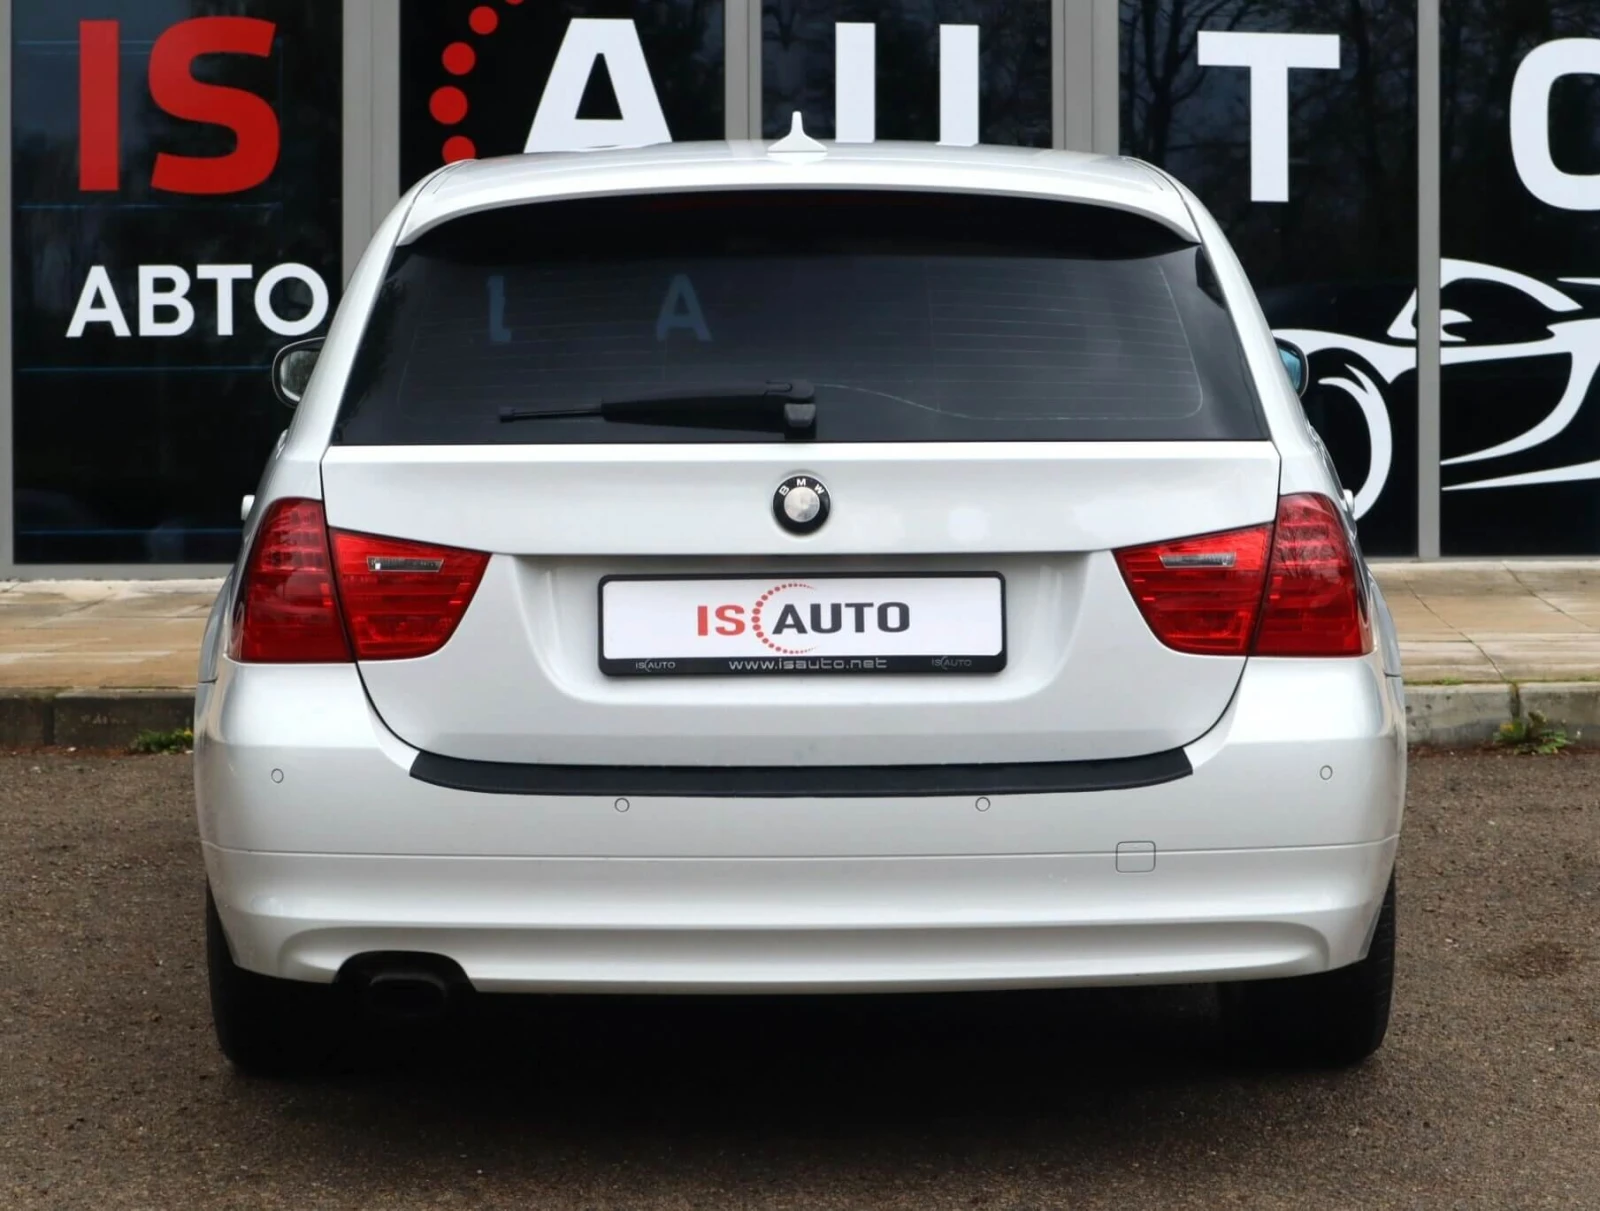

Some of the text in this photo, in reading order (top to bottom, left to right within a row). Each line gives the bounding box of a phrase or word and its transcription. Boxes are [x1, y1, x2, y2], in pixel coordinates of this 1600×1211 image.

[79, 16, 280, 194] IS
[66, 262, 329, 338] АВТО
[778, 477, 825, 496] BMW
[697, 601, 910, 636] IS AUTO
[728, 657, 888, 671] www.isauto.net
